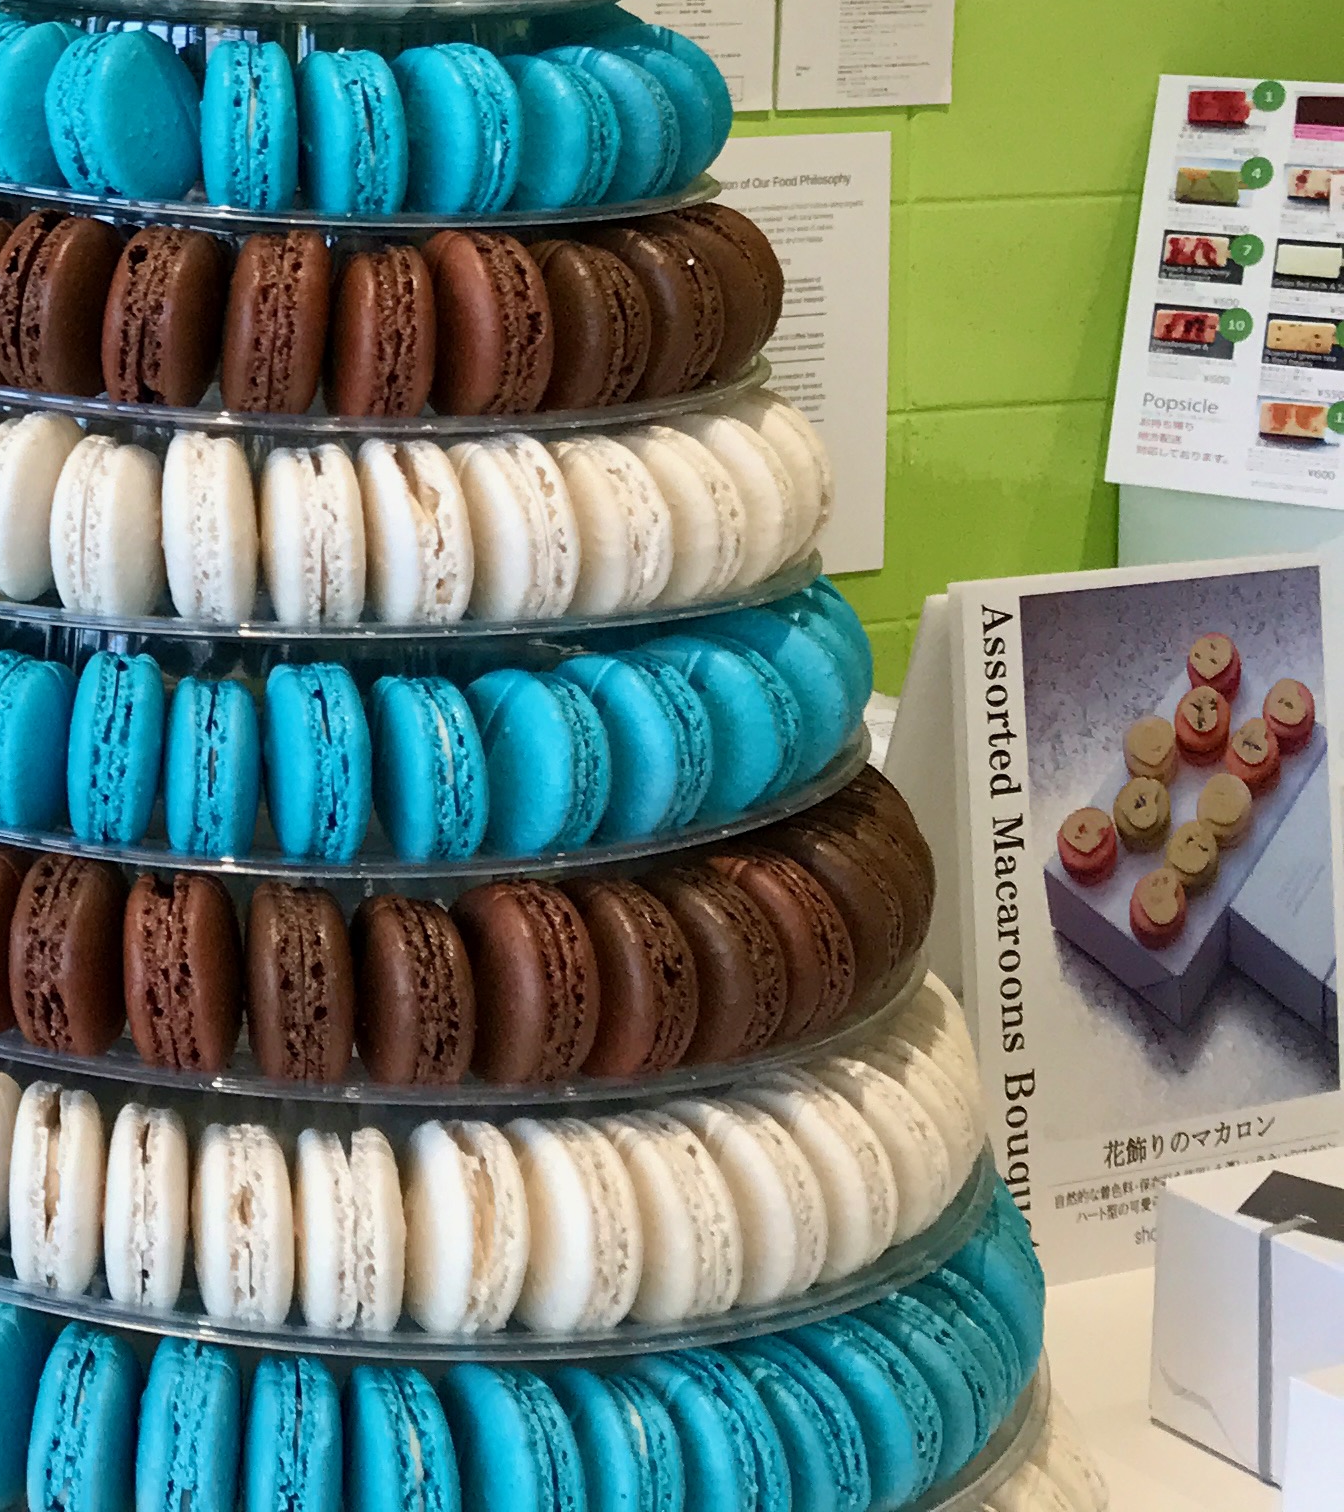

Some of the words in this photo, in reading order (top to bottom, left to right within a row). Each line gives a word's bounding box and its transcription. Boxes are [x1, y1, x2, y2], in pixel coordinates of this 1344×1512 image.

[1264, 90, 1274, 103] 1
[740, 178, 750, 190] of
[752, 177, 771, 190] Our
[772, 175, 798, 188] Food
[799, 172, 853, 187] Philosophy
[1250, 166, 1263, 180] 4
[1241, 244, 1254, 257] 7
[1229, 319, 1247, 332] 10
[1142, 391, 1220, 415] Popsicle
[979, 603, 1023, 800] Assorted
[991, 813, 1029, 1055] Macaroons
[1103, 1115, 1277, 1170] 花飾りのマカロン
[1003, 1068, 1040, 1248] Bouqu
